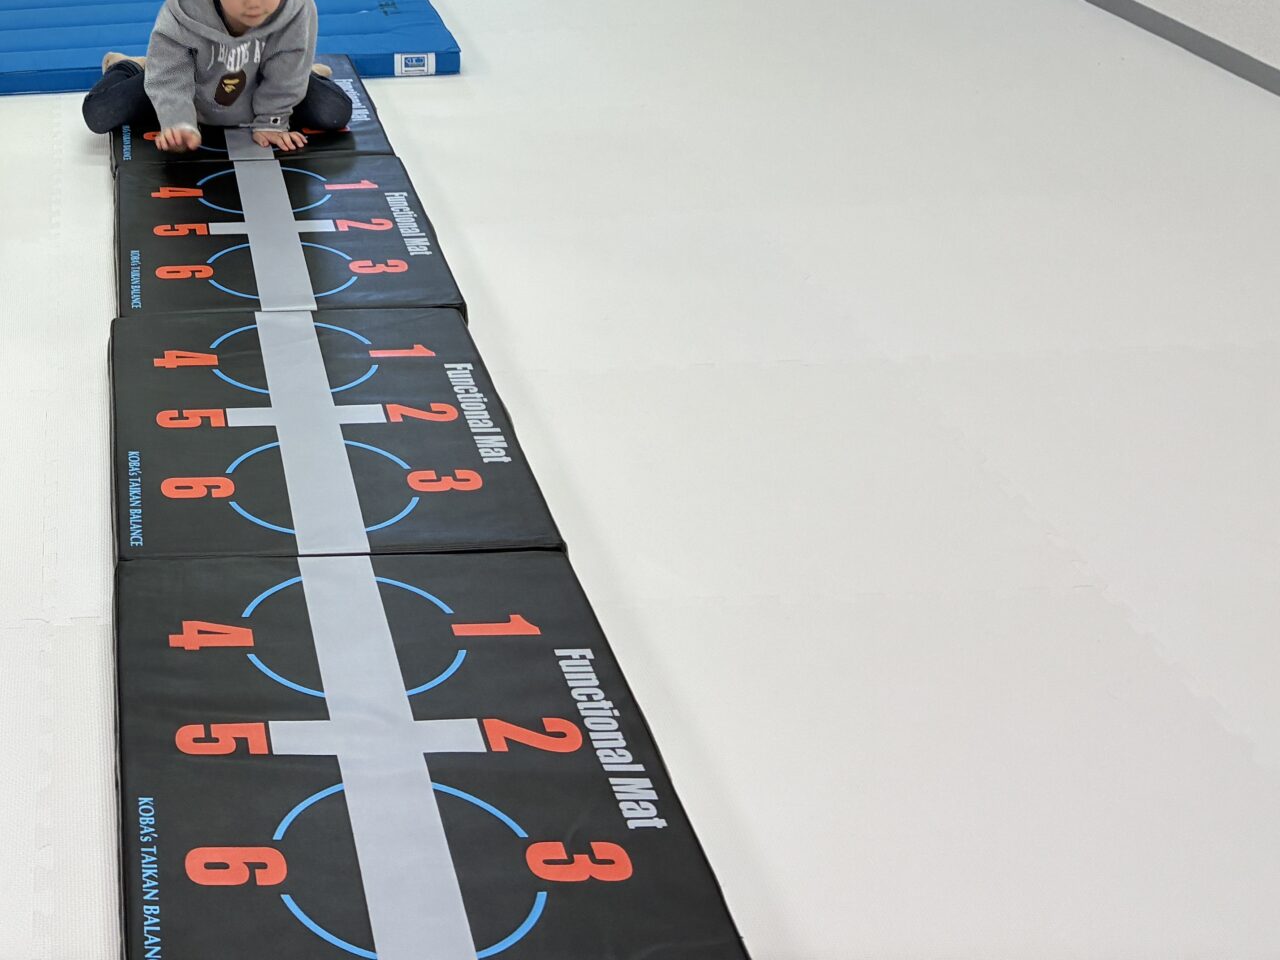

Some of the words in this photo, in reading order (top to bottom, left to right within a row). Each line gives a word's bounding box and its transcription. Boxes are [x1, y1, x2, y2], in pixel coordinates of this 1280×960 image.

[150, 186, 204, 199] 4
[324, 178, 379, 191] 1
[334, 217, 394, 232] 2
[384, 191, 426, 237] Functional
[152, 223, 210, 237] 5
[403, 237, 433, 256] Mat
[155, 264, 214, 280] 6
[349, 259, 409, 274] 3
[153, 349, 219, 369] 4
[369, 343, 437, 358] 1
[155, 408, 227, 429] 5
[385, 402, 460, 424] 2
[444, 362, 500, 434] Functional
[473, 434, 513, 464] Mat
[128, 477, 142, 507] TAIKAN
[160, 476, 236, 499] 6
[407, 468, 484, 493] 3
[129, 508, 144, 547] BALANCE
[168, 620, 255, 651] 4
[451, 614, 542, 637] 1
[174, 722, 269, 755] 5
[482, 717, 583, 753] 2
[554, 648, 647, 775] Functional
[609, 777, 668, 830] Mat
[138, 797, 158, 842] KOBA's
[140, 845, 160, 901] TAIKAN
[184, 846, 288, 886] 6
[525, 841, 634, 883] 3
[143, 905, 162, 960] BALAN
